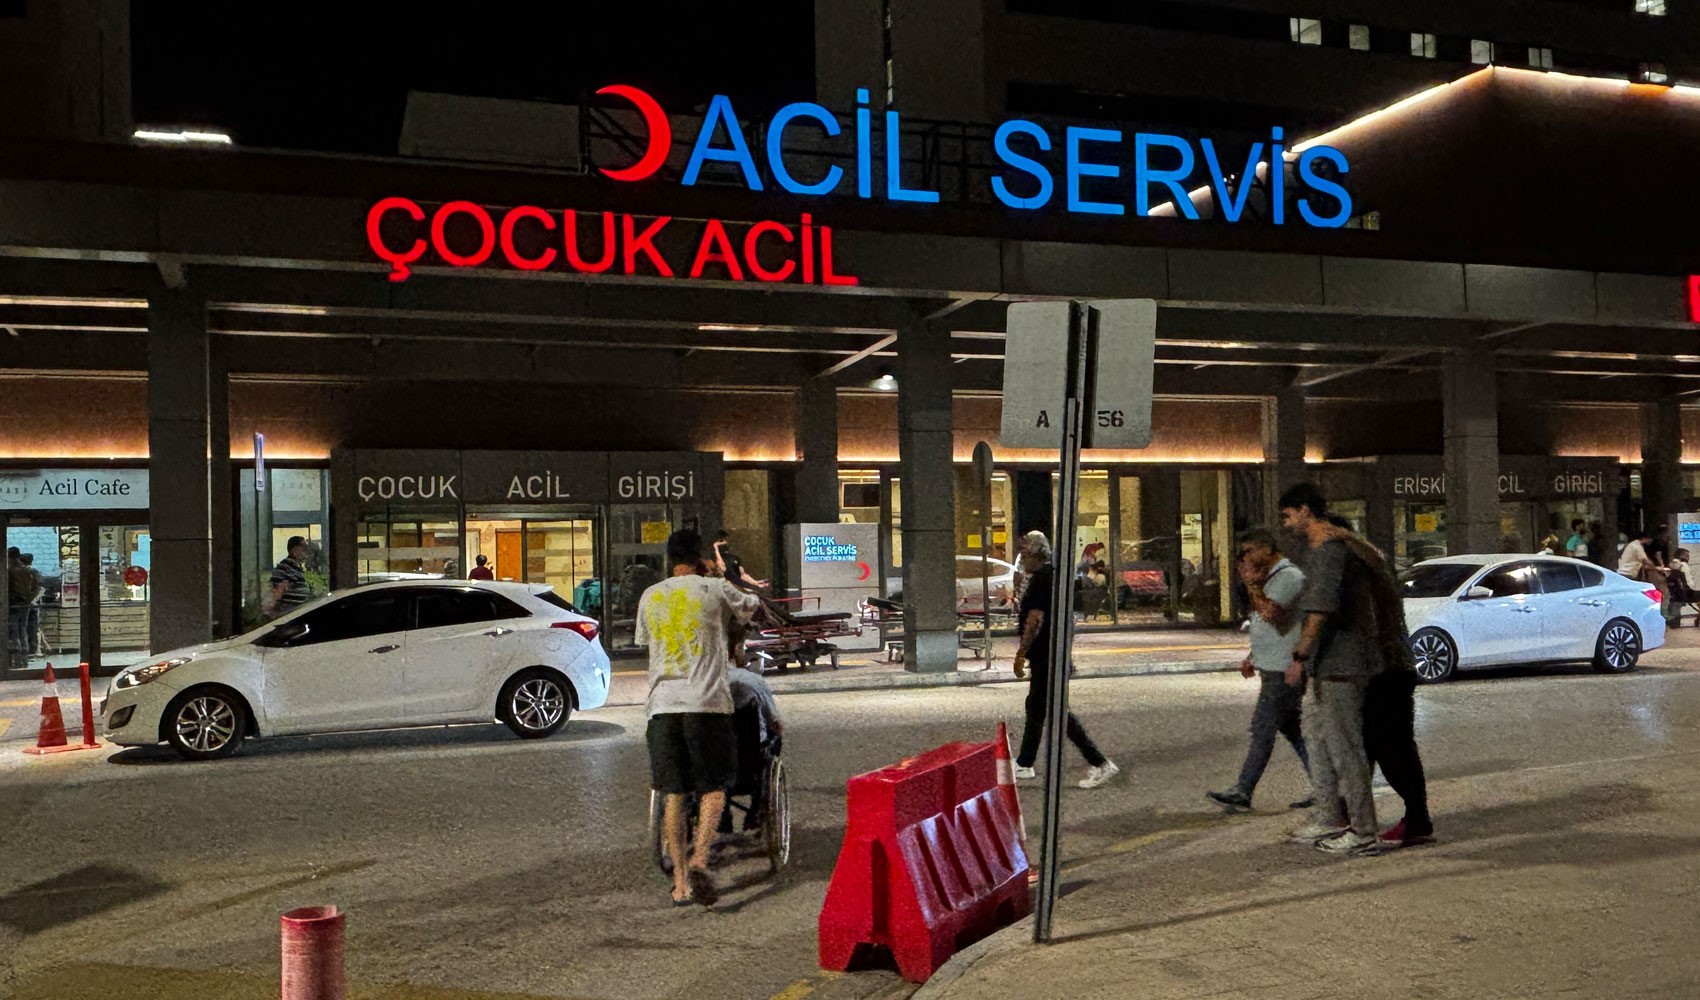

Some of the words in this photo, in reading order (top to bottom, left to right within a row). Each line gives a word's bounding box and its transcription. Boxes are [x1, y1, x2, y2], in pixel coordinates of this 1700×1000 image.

[681, 88, 940, 203] ACİL
[991, 119, 1352, 228] SERVİS
[366, 197, 674, 282] ÇOCUK
[690, 212, 859, 288] ACİL
[1036, 410, 1050, 428] A
[1097, 410, 1125, 428] 56
[39, 479, 77, 495] Acil
[84, 479, 130, 495] Cafe
[358, 475, 458, 502] ÇOCUK
[506, 470, 570, 498] ACİL
[618, 470, 693, 499] GİRİŞİ
[1394, 473, 1446, 496] ERİŞKİ
[1497, 472, 1525, 493] CİL
